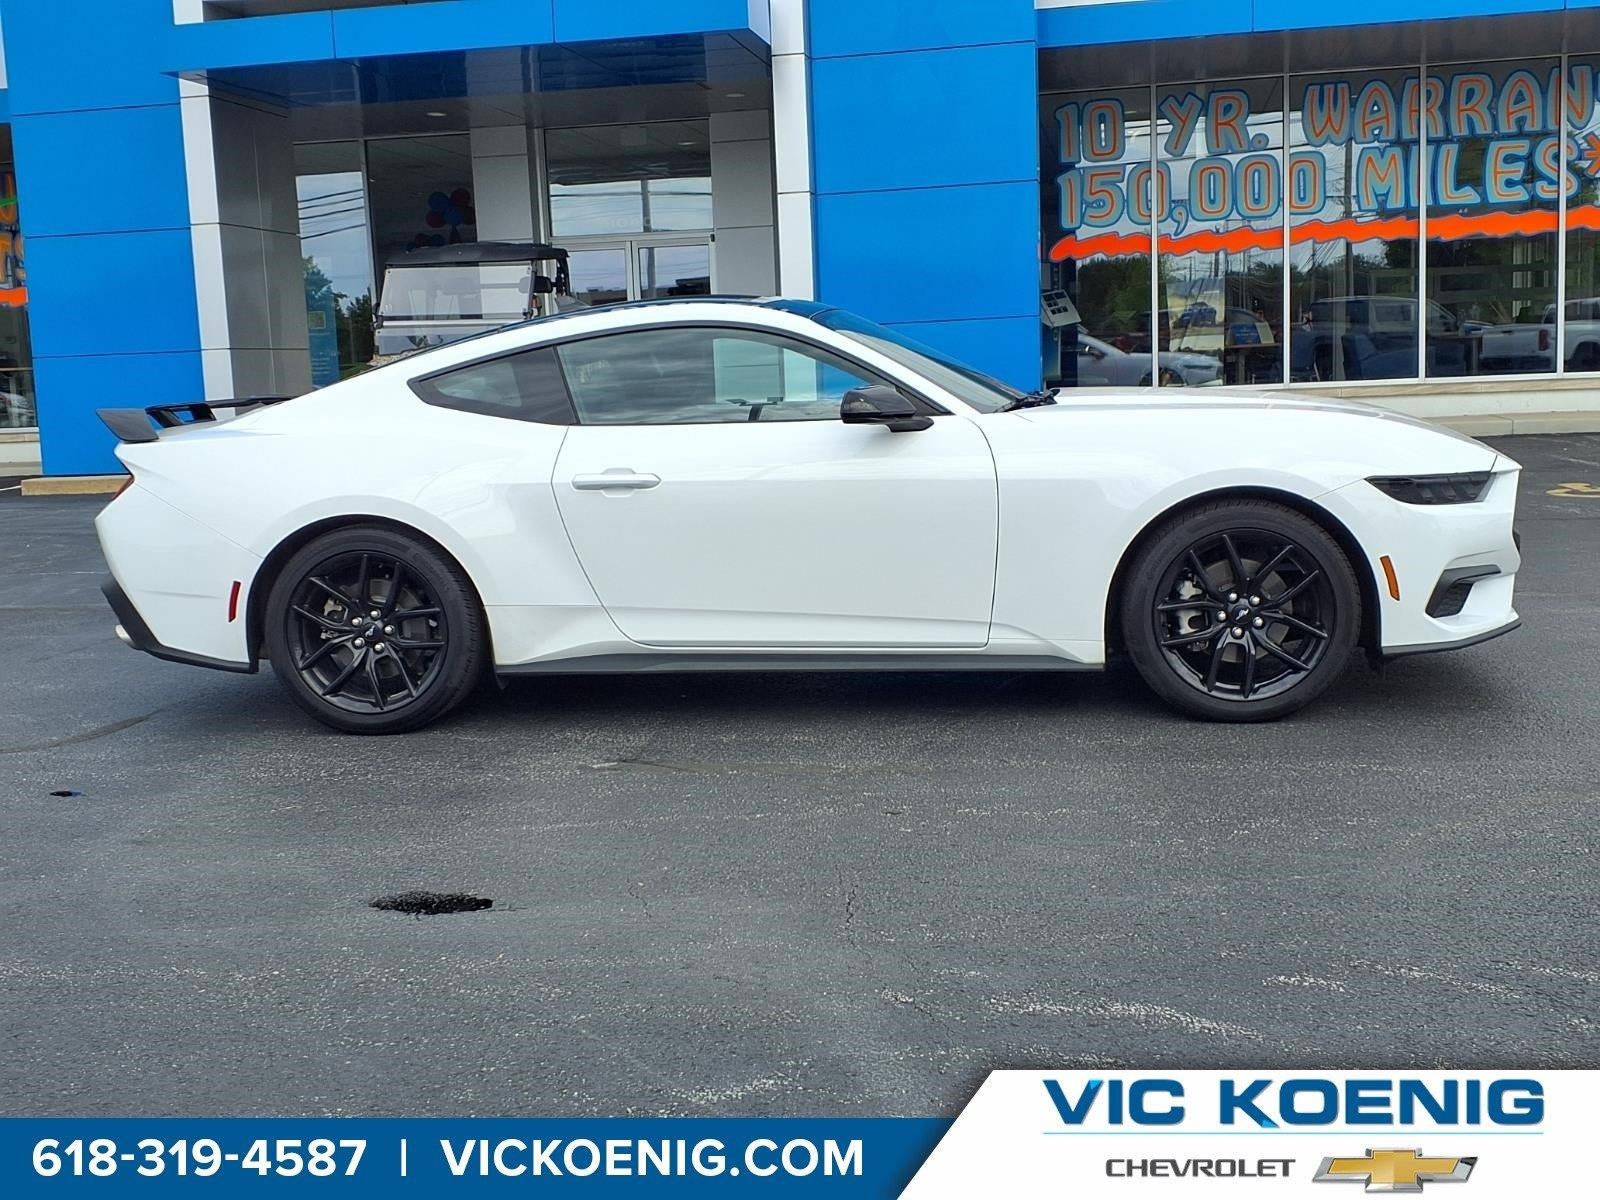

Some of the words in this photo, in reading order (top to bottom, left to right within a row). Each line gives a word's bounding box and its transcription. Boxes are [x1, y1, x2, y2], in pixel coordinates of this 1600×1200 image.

[1056, 97, 1125, 164] 10
[1159, 88, 1270, 158] YR.
[1302, 62, 1600, 148] WARRAN
[1056, 150, 1327, 238] 150,000
